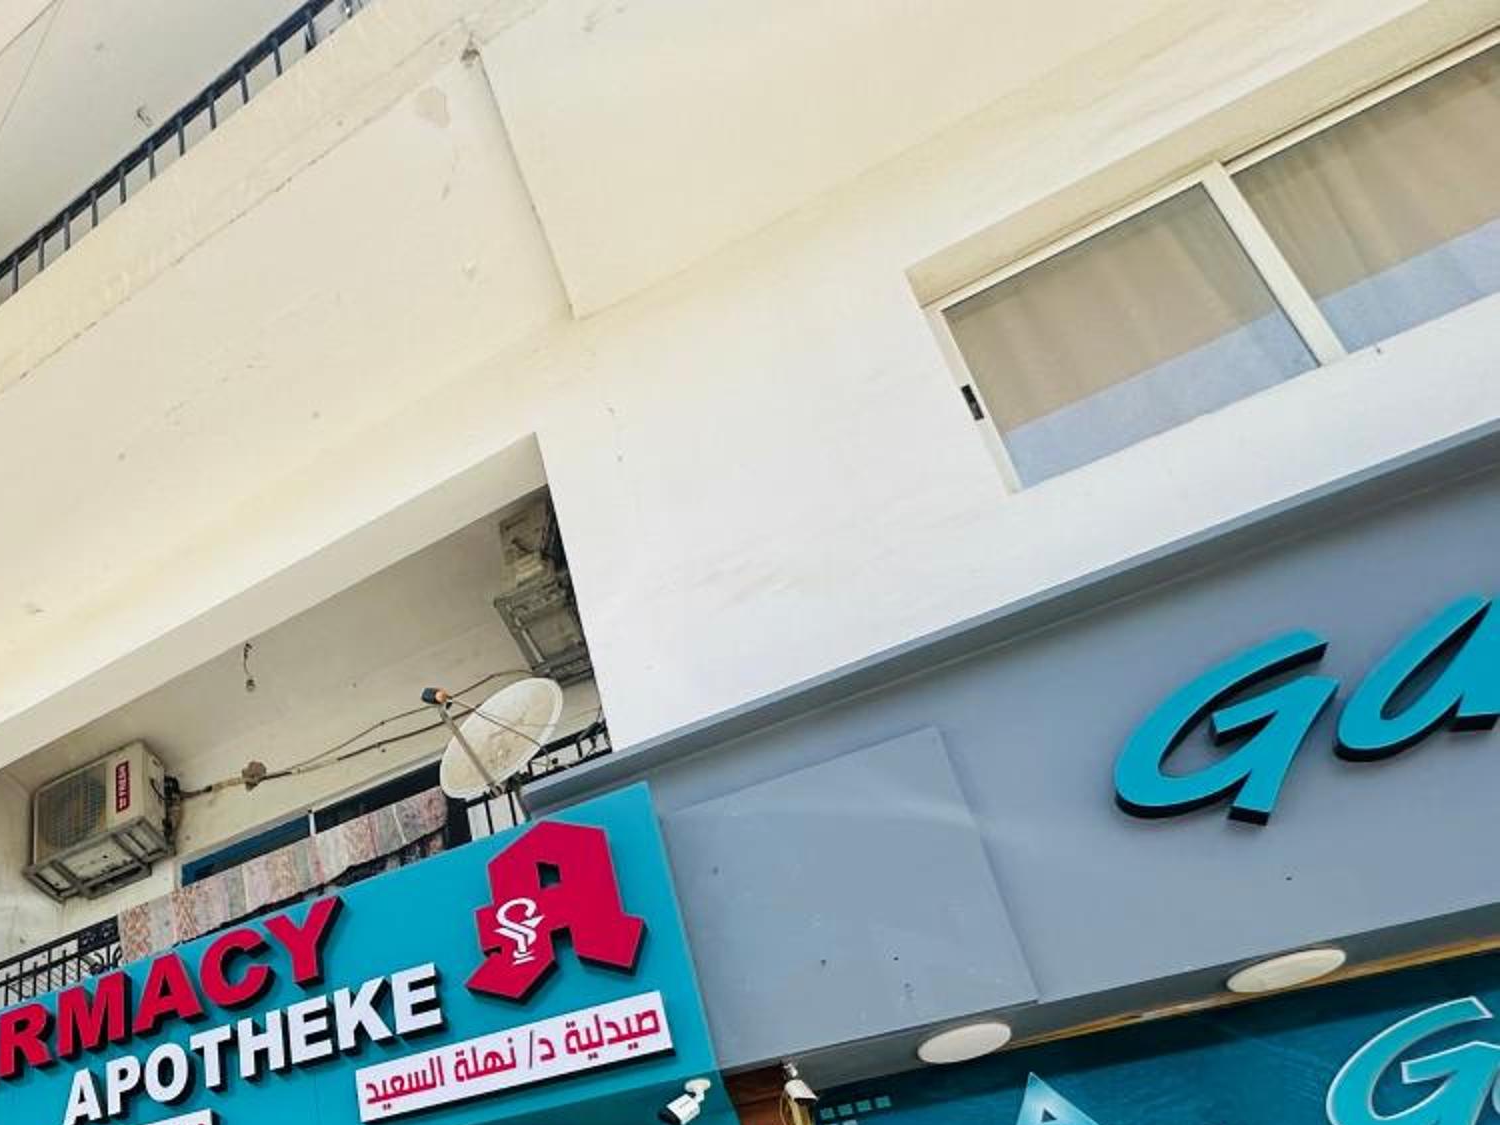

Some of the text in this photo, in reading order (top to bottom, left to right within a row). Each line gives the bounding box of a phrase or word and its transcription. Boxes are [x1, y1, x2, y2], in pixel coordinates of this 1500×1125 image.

[564, 1007, 661, 1060] صيدلية
[365, 1055, 445, 1110] السعيد
[453, 1037, 518, 1084] نهلة
